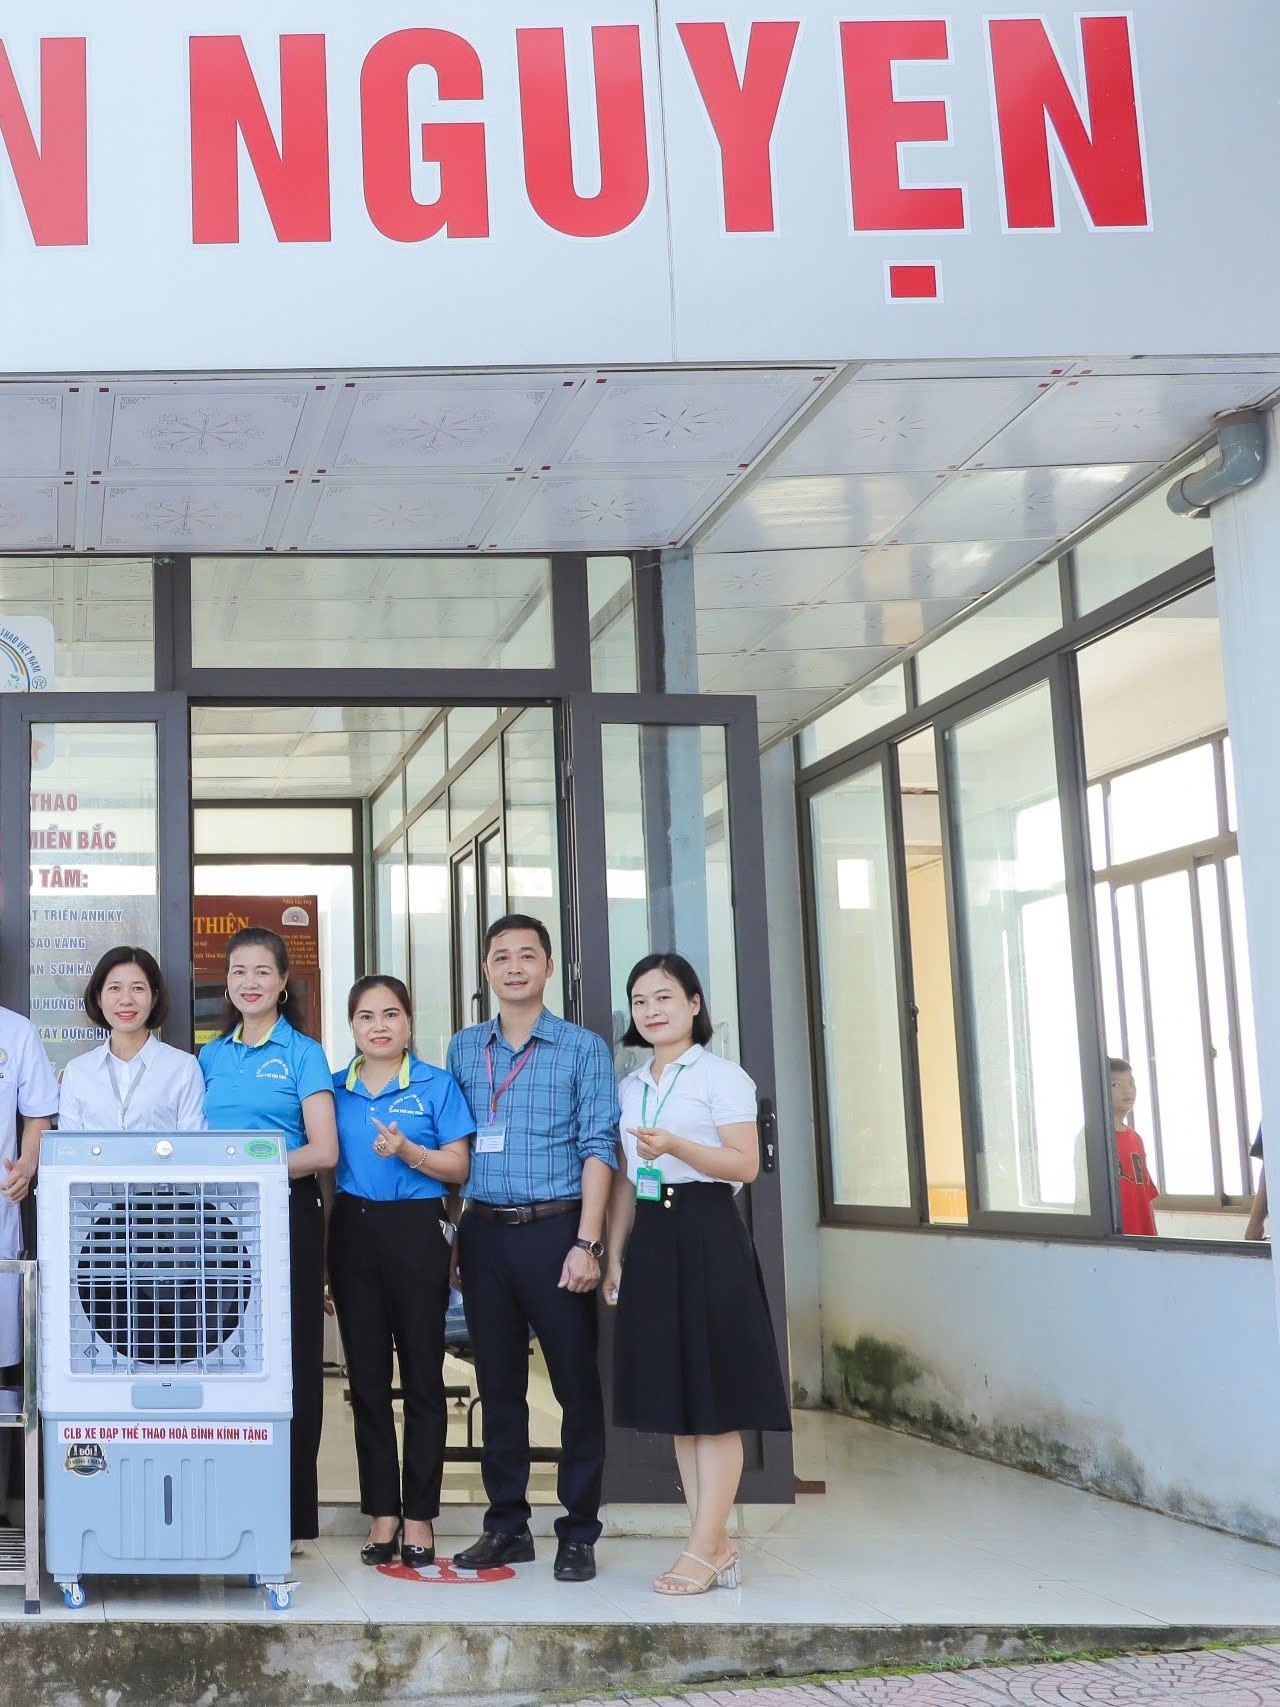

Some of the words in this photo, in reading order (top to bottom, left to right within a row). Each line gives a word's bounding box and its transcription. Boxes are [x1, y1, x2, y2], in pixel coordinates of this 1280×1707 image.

[77, 822, 117, 850] BẮC
[81, 910, 105, 922] ANH
[55, 934, 86, 949] VÀNG
[77, 960, 93, 975] HÀ
[64, 1427, 82, 1440] CLB
[85, 1428, 97, 1440] XE
[100, 1427, 119, 1442] ĐẠP
[122, 1422, 140, 1440] THỂ
[142, 1428, 166, 1440] THAO
[191, 1425, 214, 1440] BÌNH
[217, 1425, 240, 1440] KÍNH
[242, 1426, 268, 1443] TẶNG
